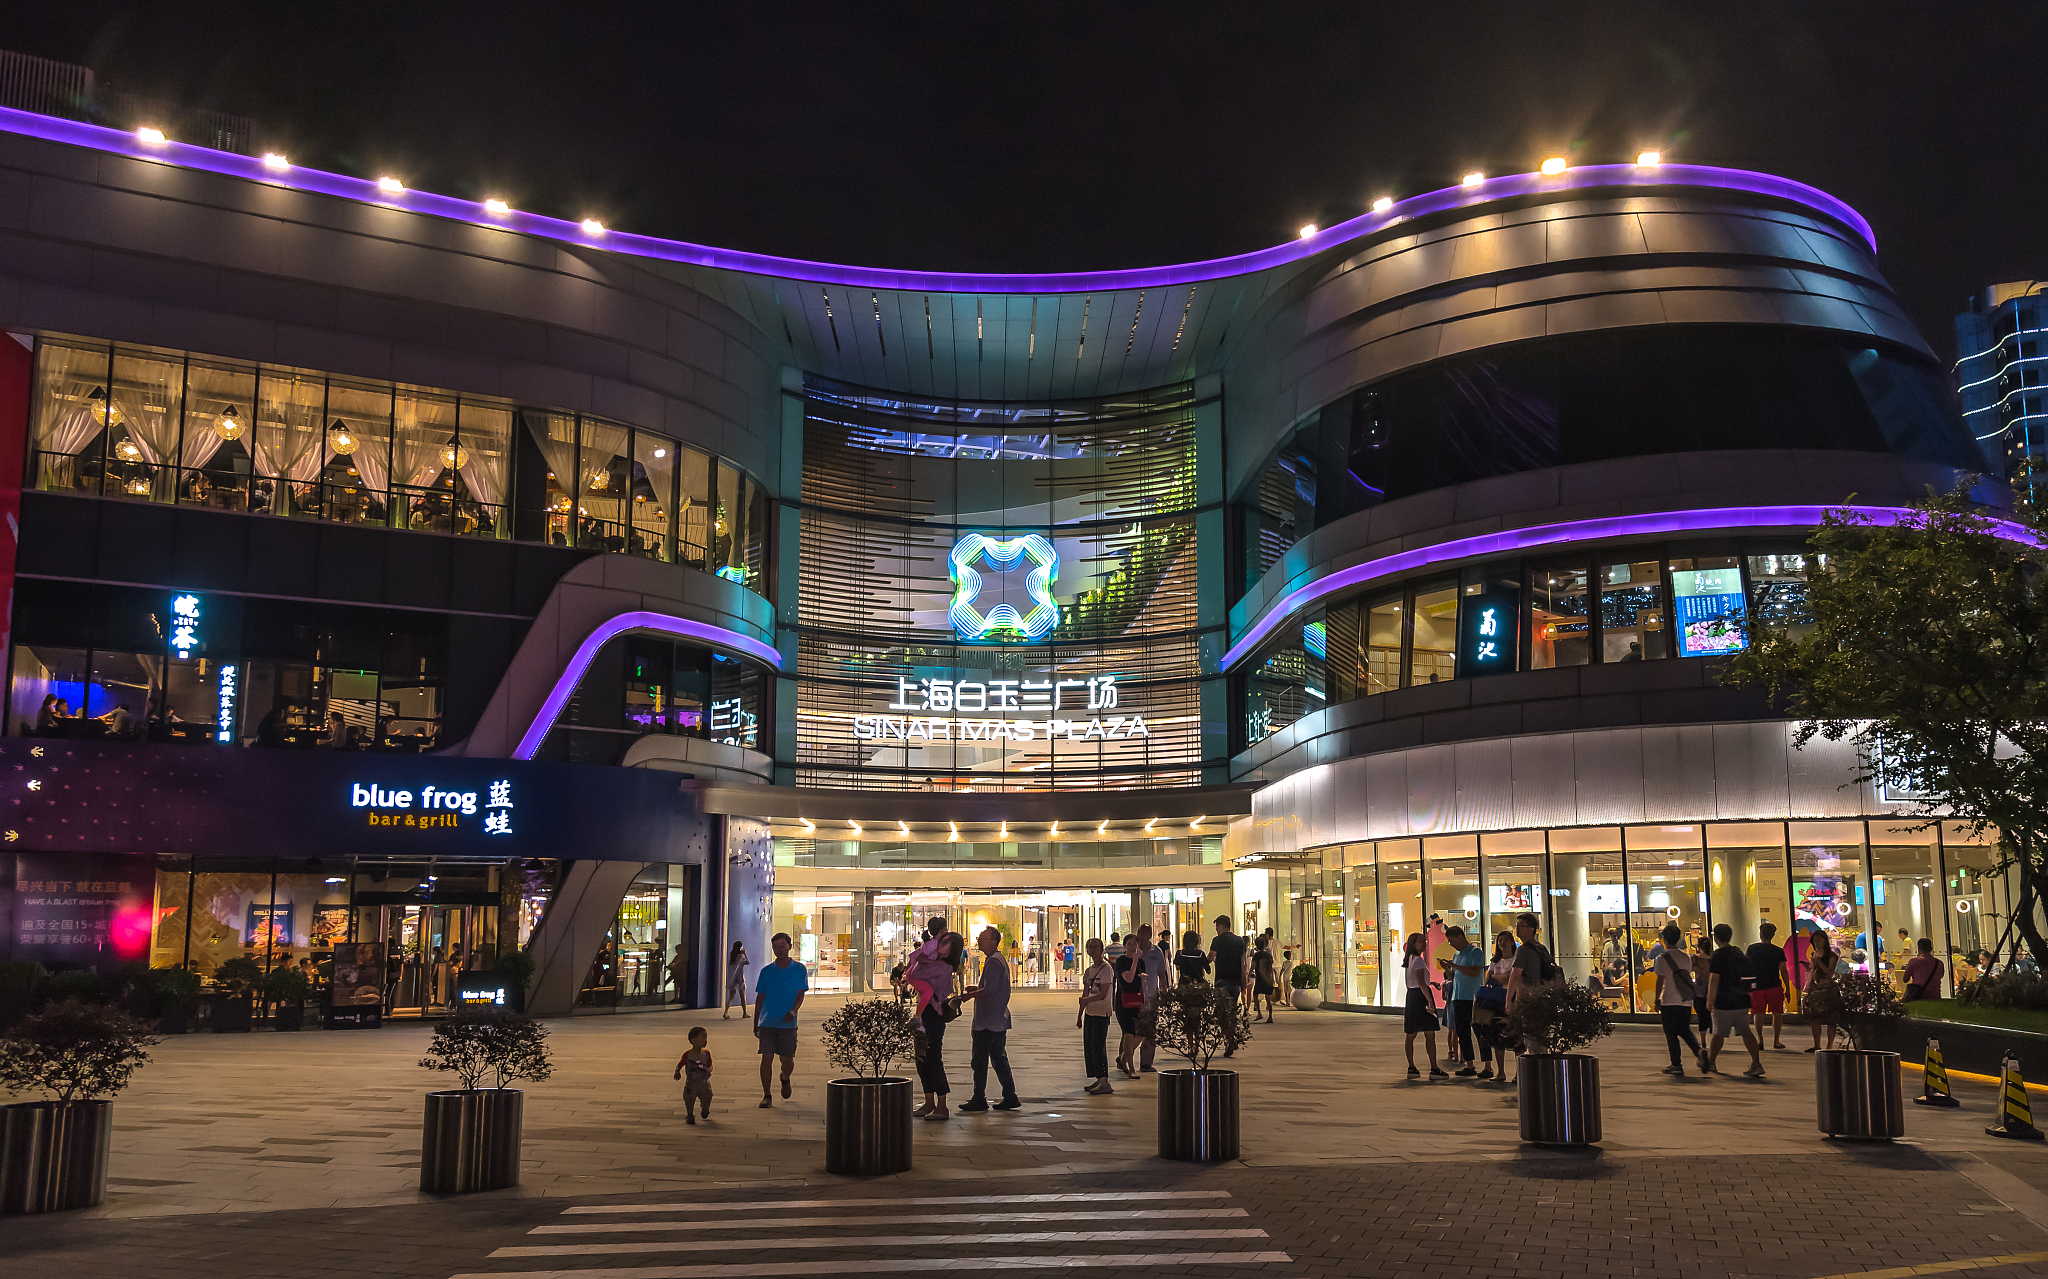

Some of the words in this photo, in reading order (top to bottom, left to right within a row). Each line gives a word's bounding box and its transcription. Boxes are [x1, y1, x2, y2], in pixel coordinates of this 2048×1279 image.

[889, 676, 1119, 711] 上海白玉兰广场
[853, 716, 950, 740] SINAR
[959, 719, 1035, 741] MAS
[1046, 715, 1149, 740] PLAZA
[352, 783, 412, 807] blue
[421, 785, 477, 815] frog
[484, 779, 514, 835] 蓝蛙
[368, 812, 401, 826] bar
[419, 814, 458, 829] grill
[54, 898, 78, 906] BLAST
